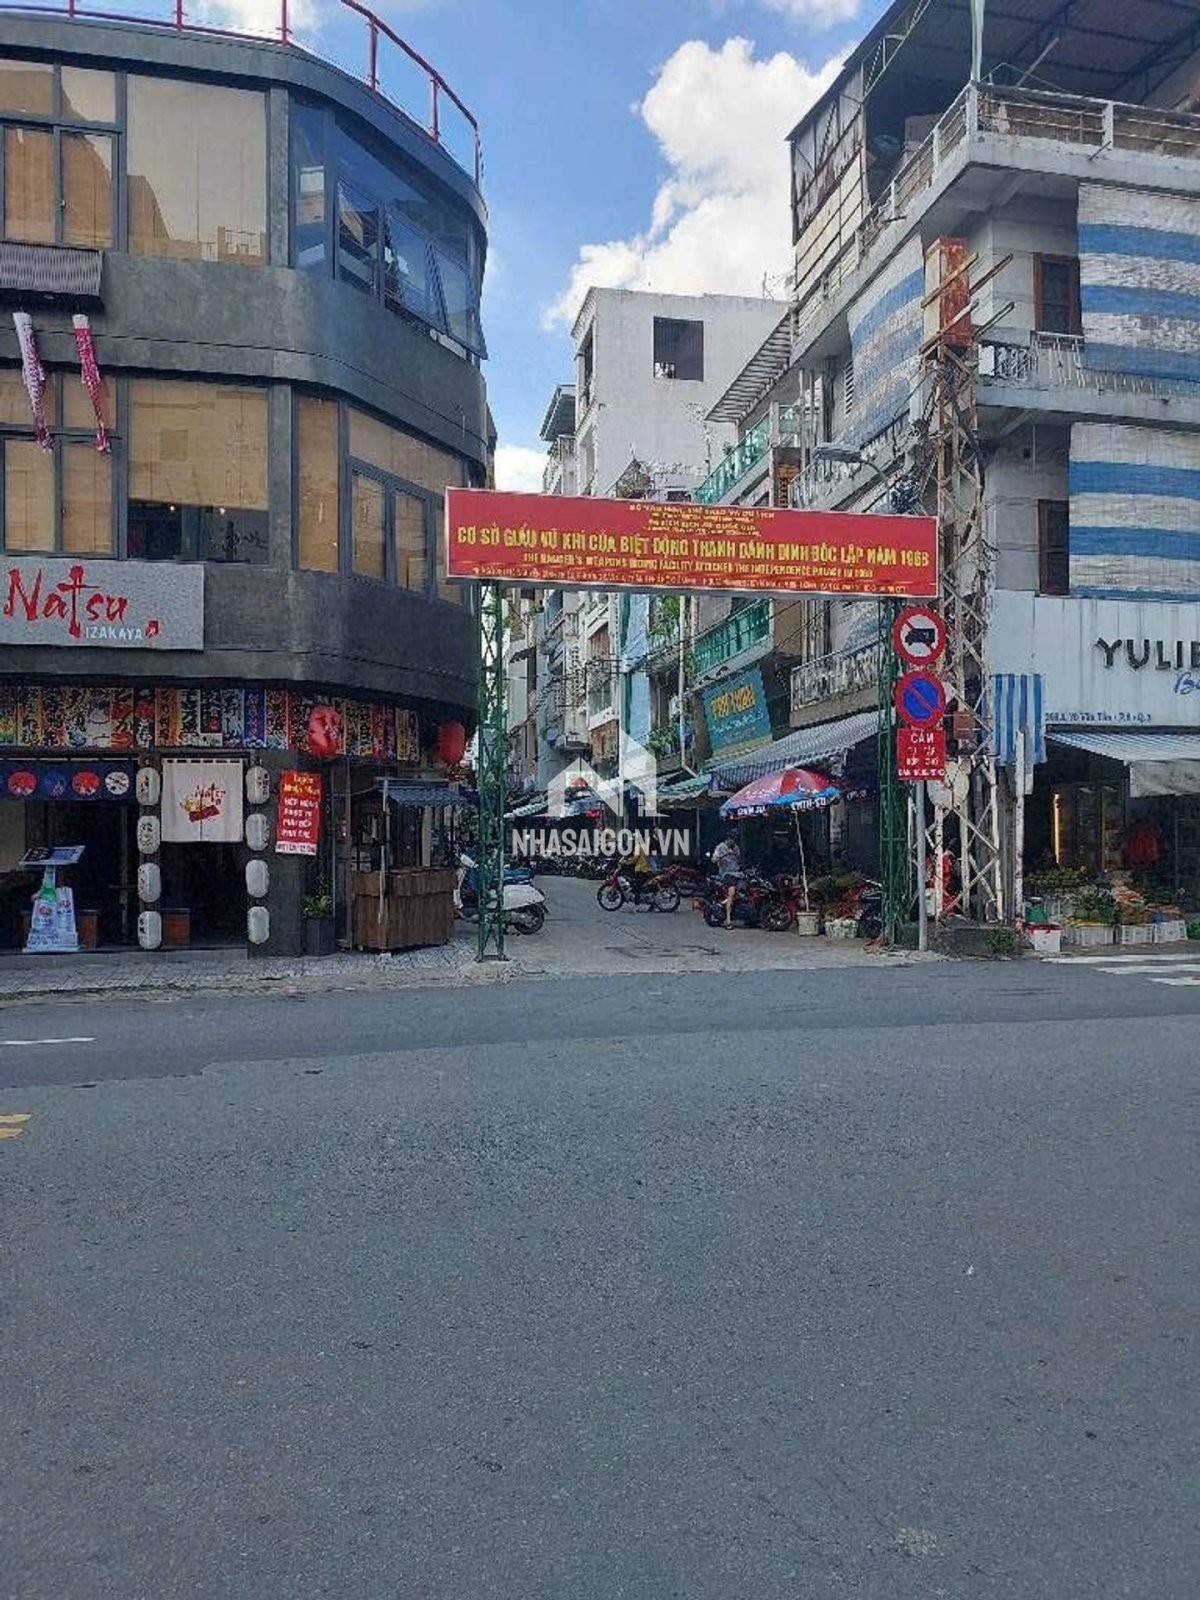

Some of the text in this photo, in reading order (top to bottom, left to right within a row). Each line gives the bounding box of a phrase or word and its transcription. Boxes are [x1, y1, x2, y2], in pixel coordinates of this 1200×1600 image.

[458, 525, 477, 545] CƠ
[480, 522, 500, 545] SỞ
[541, 528, 558, 549] VŨ
[562, 530, 586, 551] KHÍ
[589, 528, 617, 553] CỦA
[620, 533, 650, 557] BIỆT
[652, 534, 689, 558] ĐỘNG
[693, 538, 736, 558] THÀNH
[811, 542, 837, 565] ĐỘC
[841, 543, 864, 566] LẬP
[524, 552, 539, 562] THE
[660, 560, 694, 571] FACILITY
[3, 565, 128, 639] Natsu
[85, 626, 144, 641] IZAKAYA
